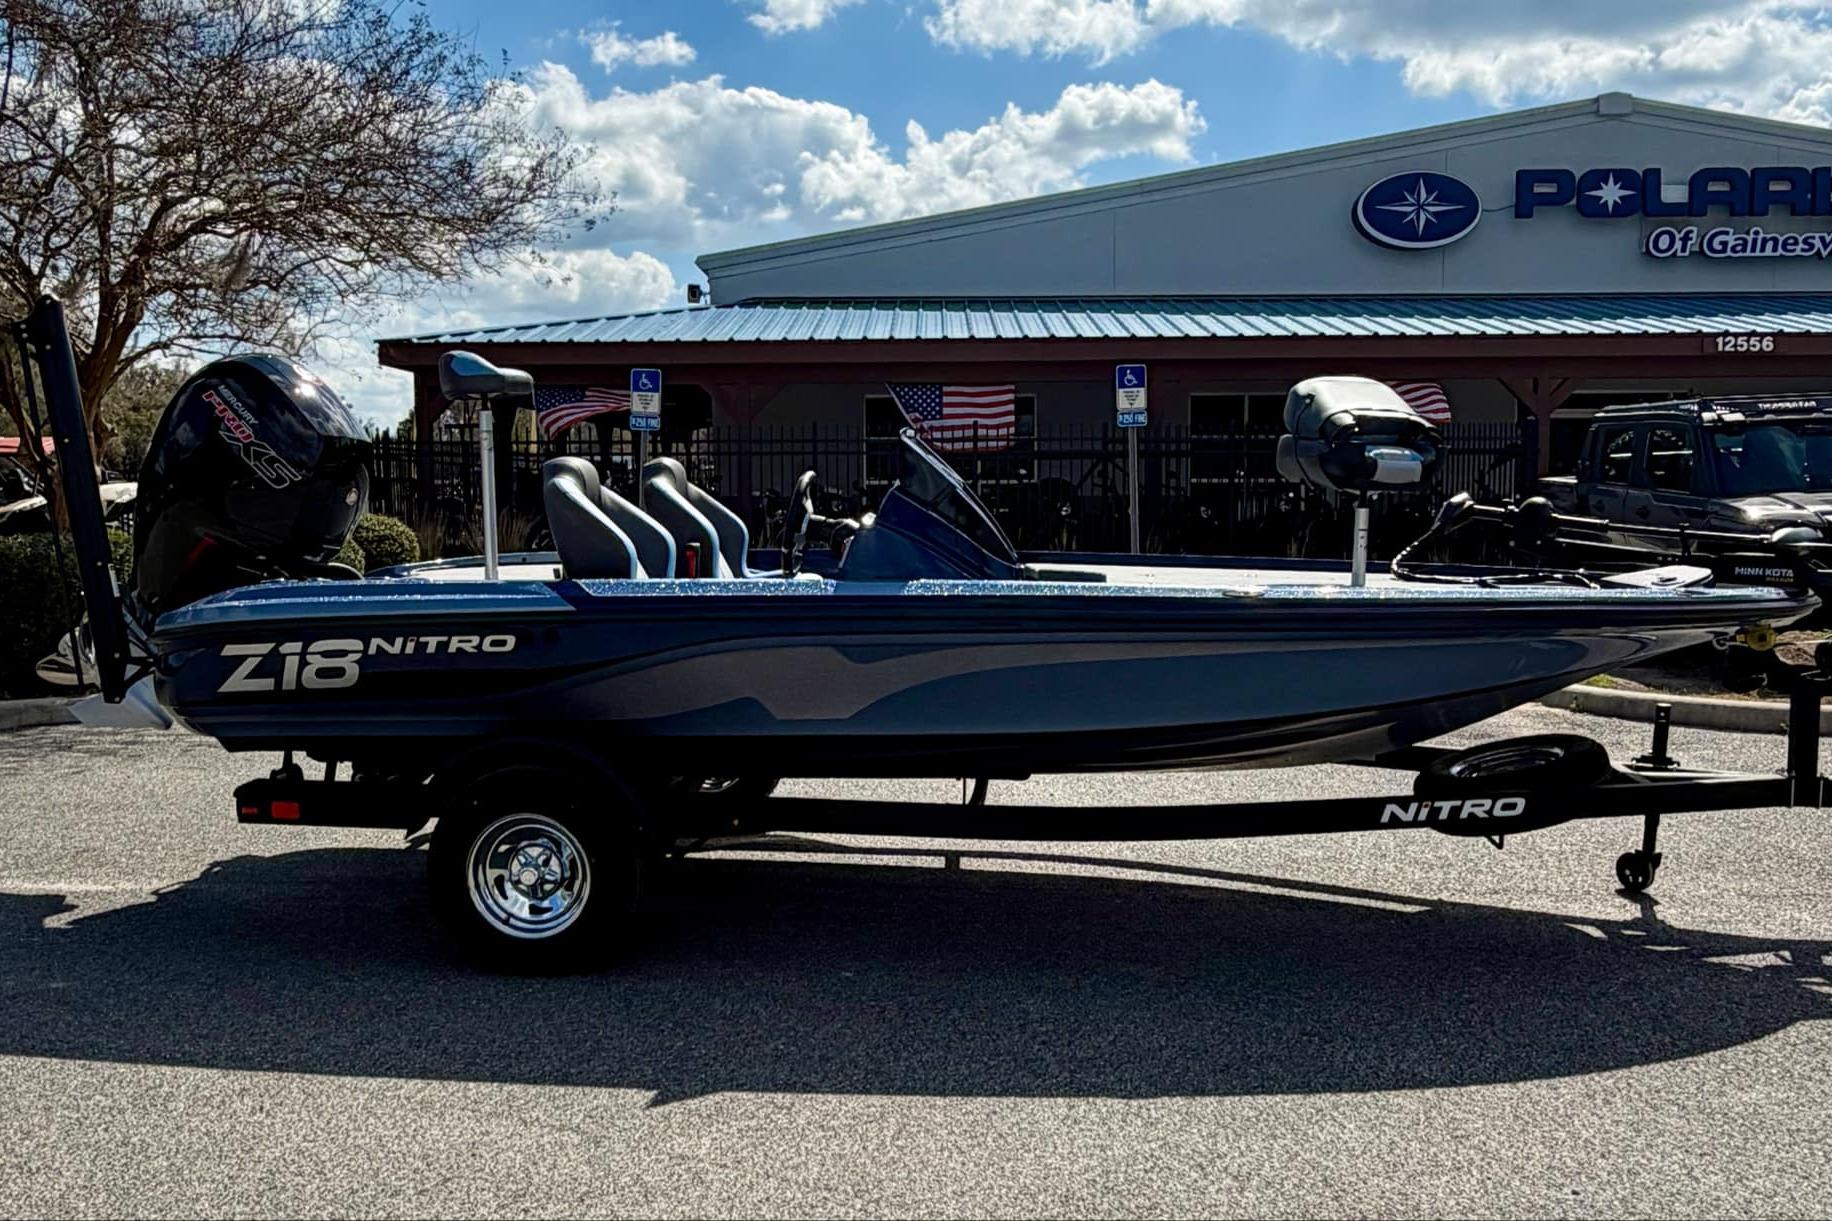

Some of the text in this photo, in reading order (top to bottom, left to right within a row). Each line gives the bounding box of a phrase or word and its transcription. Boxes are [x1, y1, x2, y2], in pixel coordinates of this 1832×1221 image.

[1649, 227, 1698, 257] Of
[1716, 336, 1774, 352] 12556
[202, 390, 255, 443] PRO
[218, 385, 259, 424] MERCURY
[218, 429, 302, 489] XS
[1734, 566, 1794, 577] MINN KOTA
[217, 639, 364, 692] Z18
